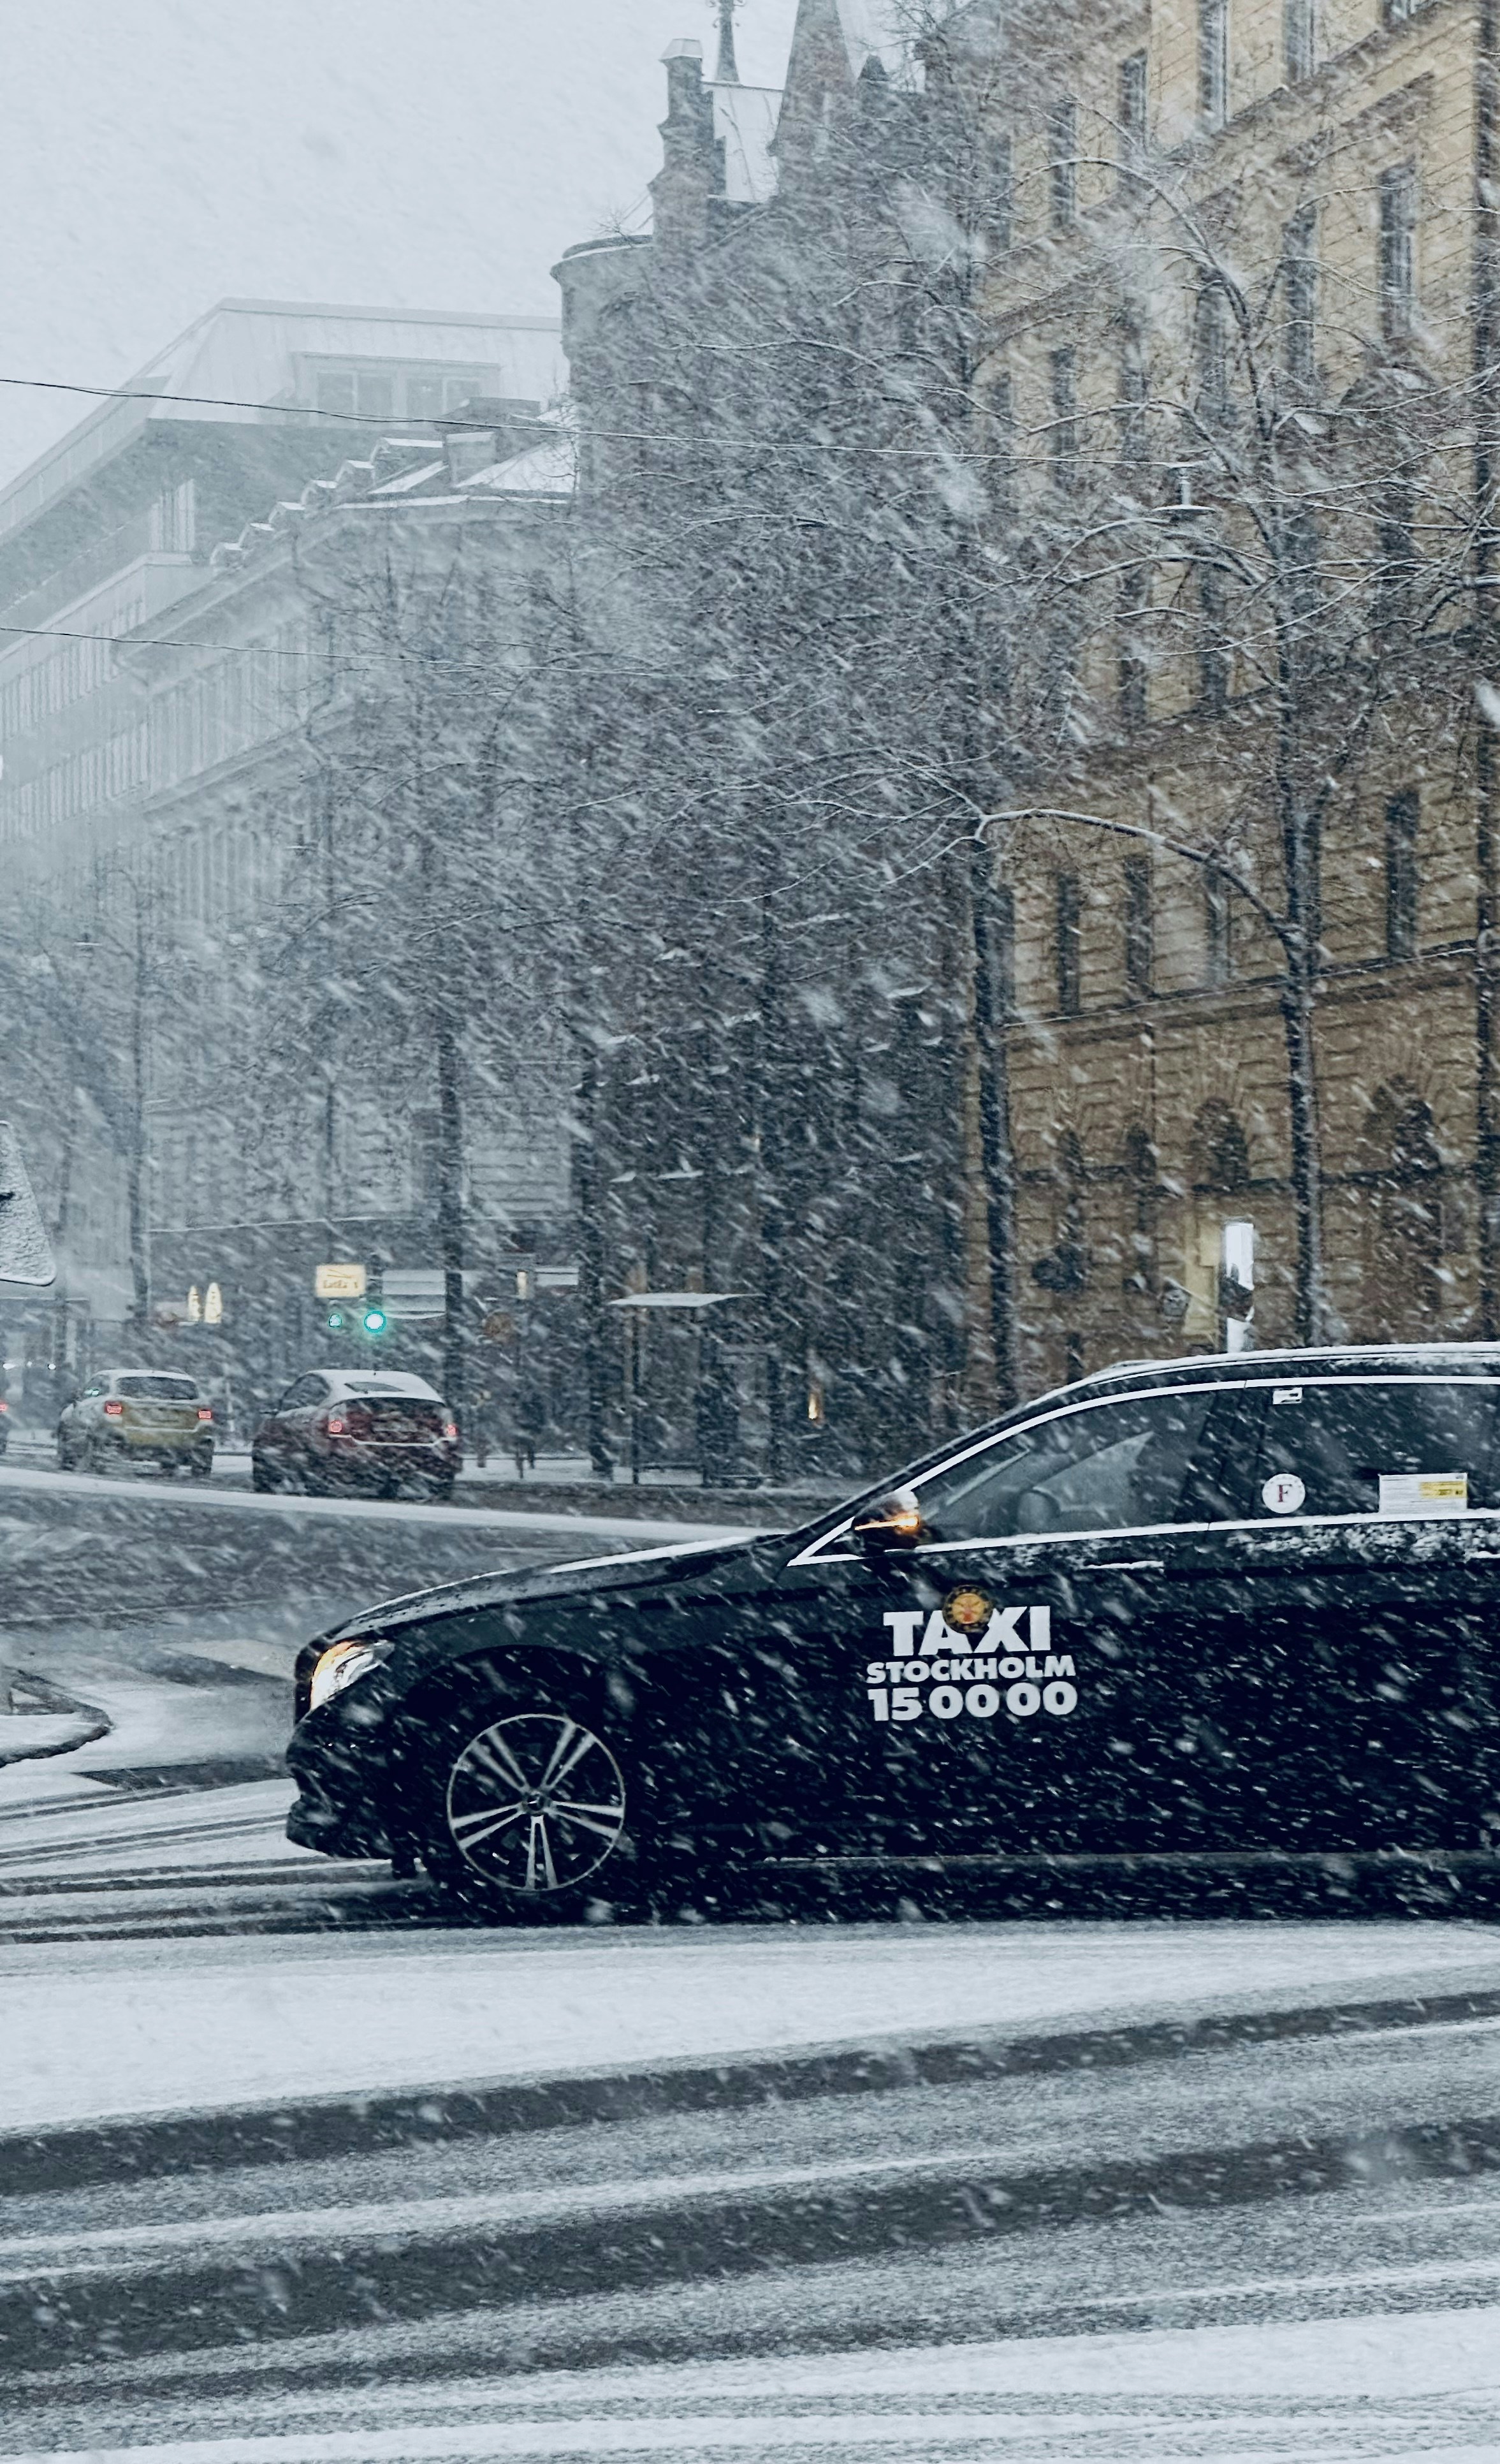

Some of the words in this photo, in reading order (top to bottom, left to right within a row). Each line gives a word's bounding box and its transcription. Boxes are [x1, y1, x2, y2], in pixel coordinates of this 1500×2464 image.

[1277, 1483, 1292, 1502] F
[883, 1605, 1051, 1657] TAXI
[866, 1655, 1077, 1684] STOCKHOLM
